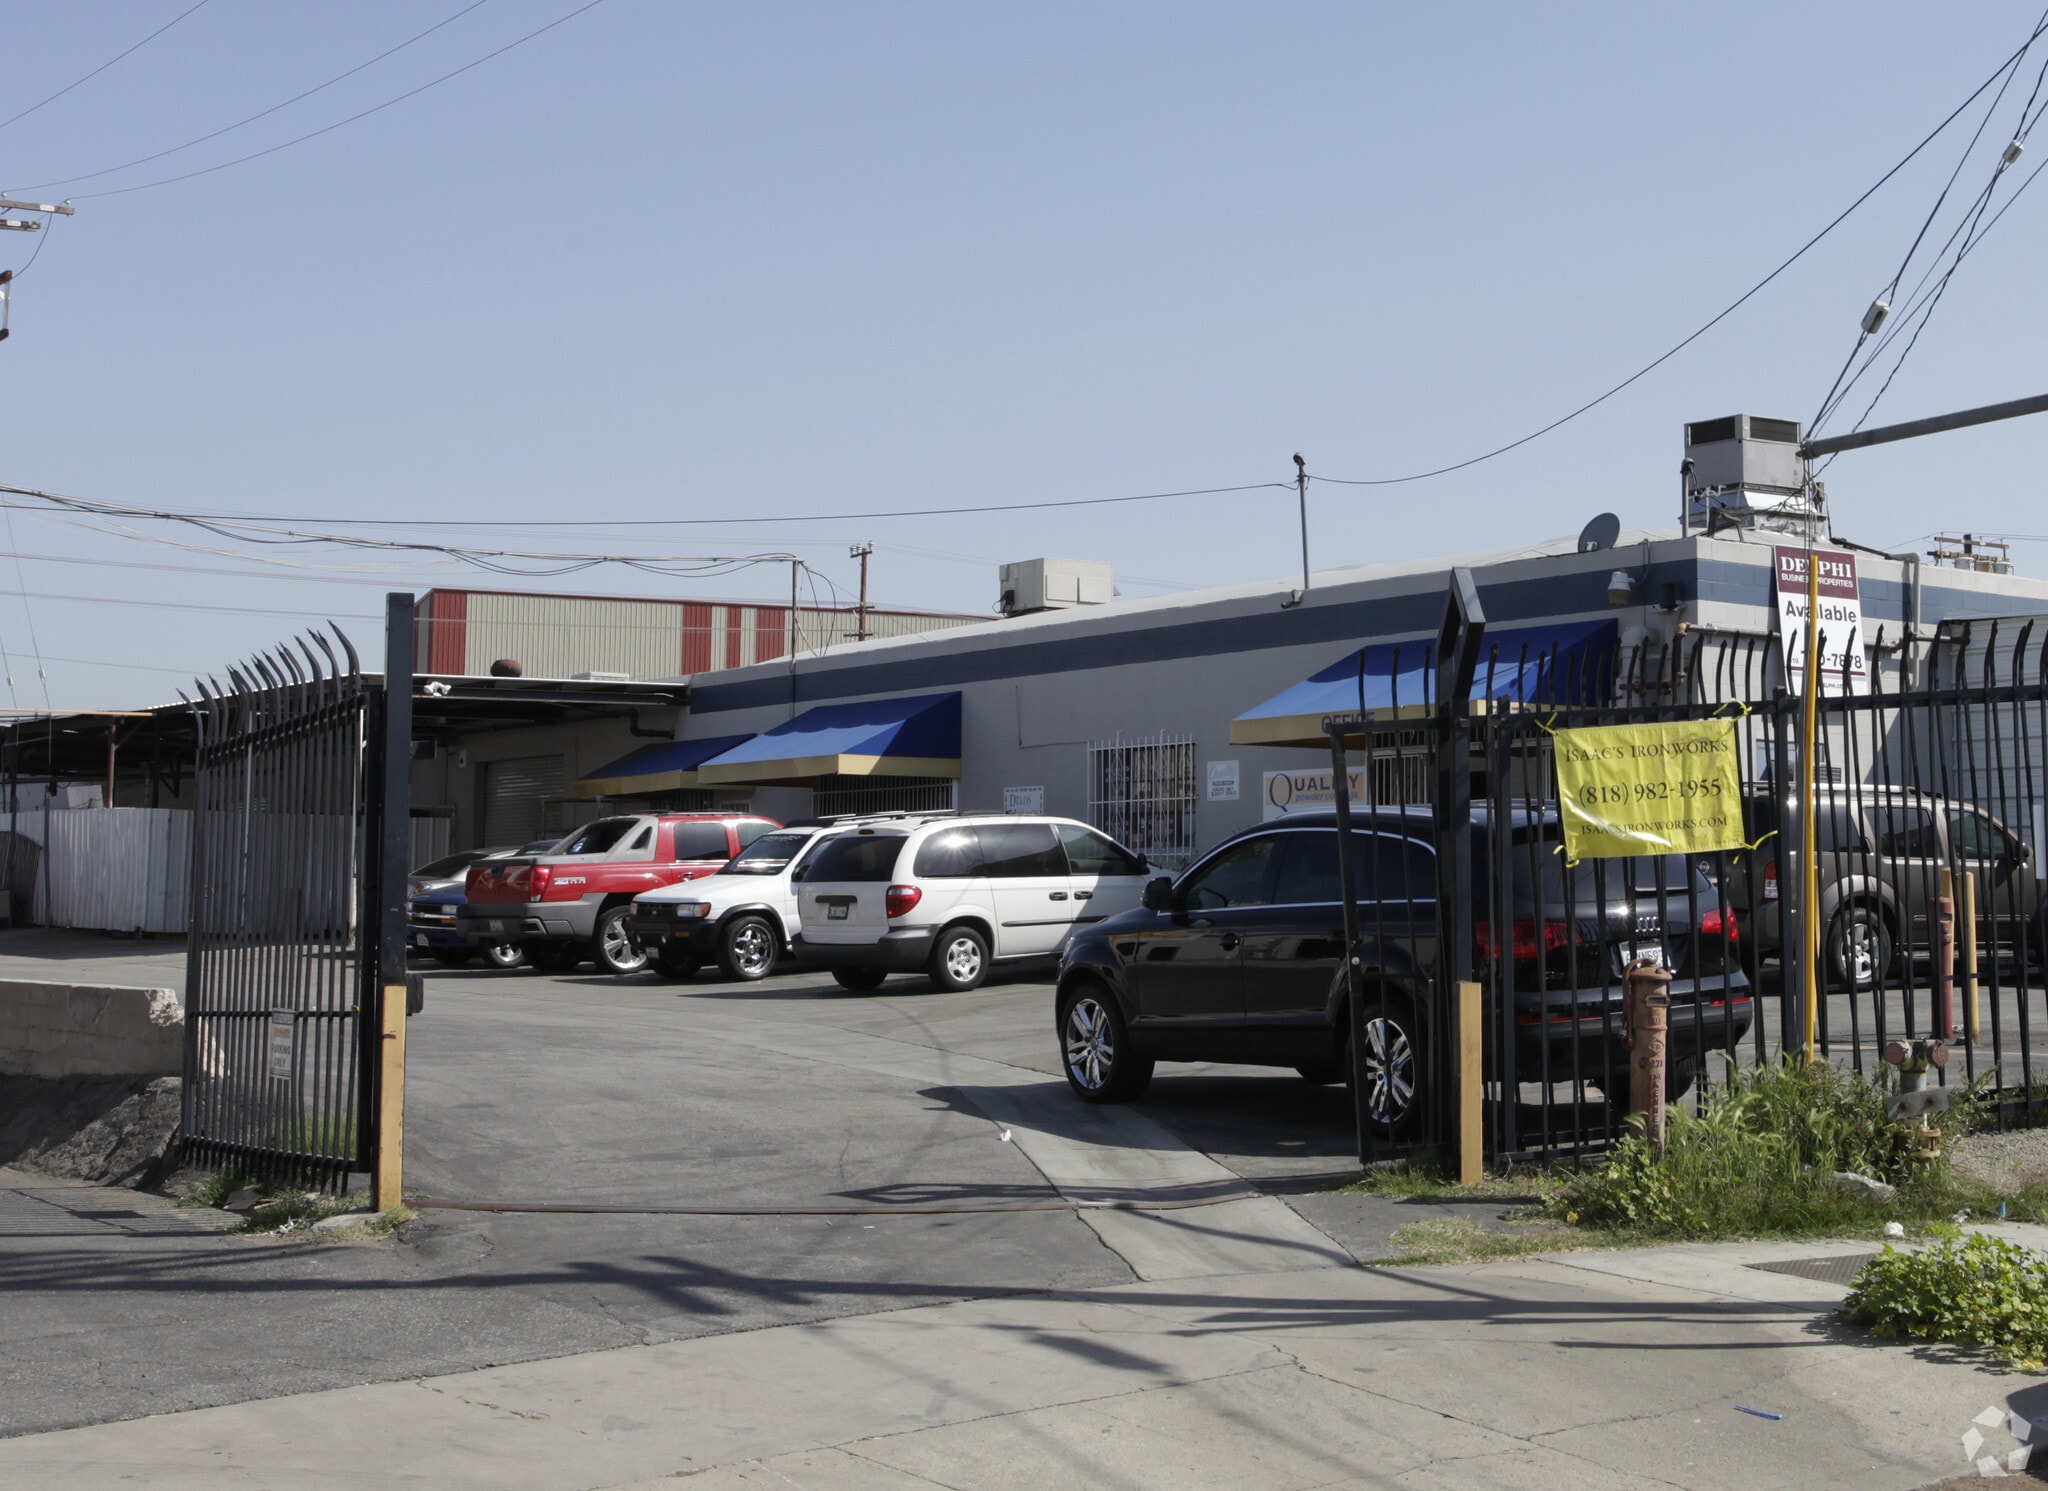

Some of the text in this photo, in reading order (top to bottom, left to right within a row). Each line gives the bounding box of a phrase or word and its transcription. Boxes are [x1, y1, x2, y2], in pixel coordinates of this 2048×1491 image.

[1781, 557, 1852, 578] DEPHI
[1566, 739, 1728, 762] ISAAC'S IRONWORKS
[1269, 773, 1359, 812] QUALIY
[1579, 778, 1722, 807] (818) 982-1955
